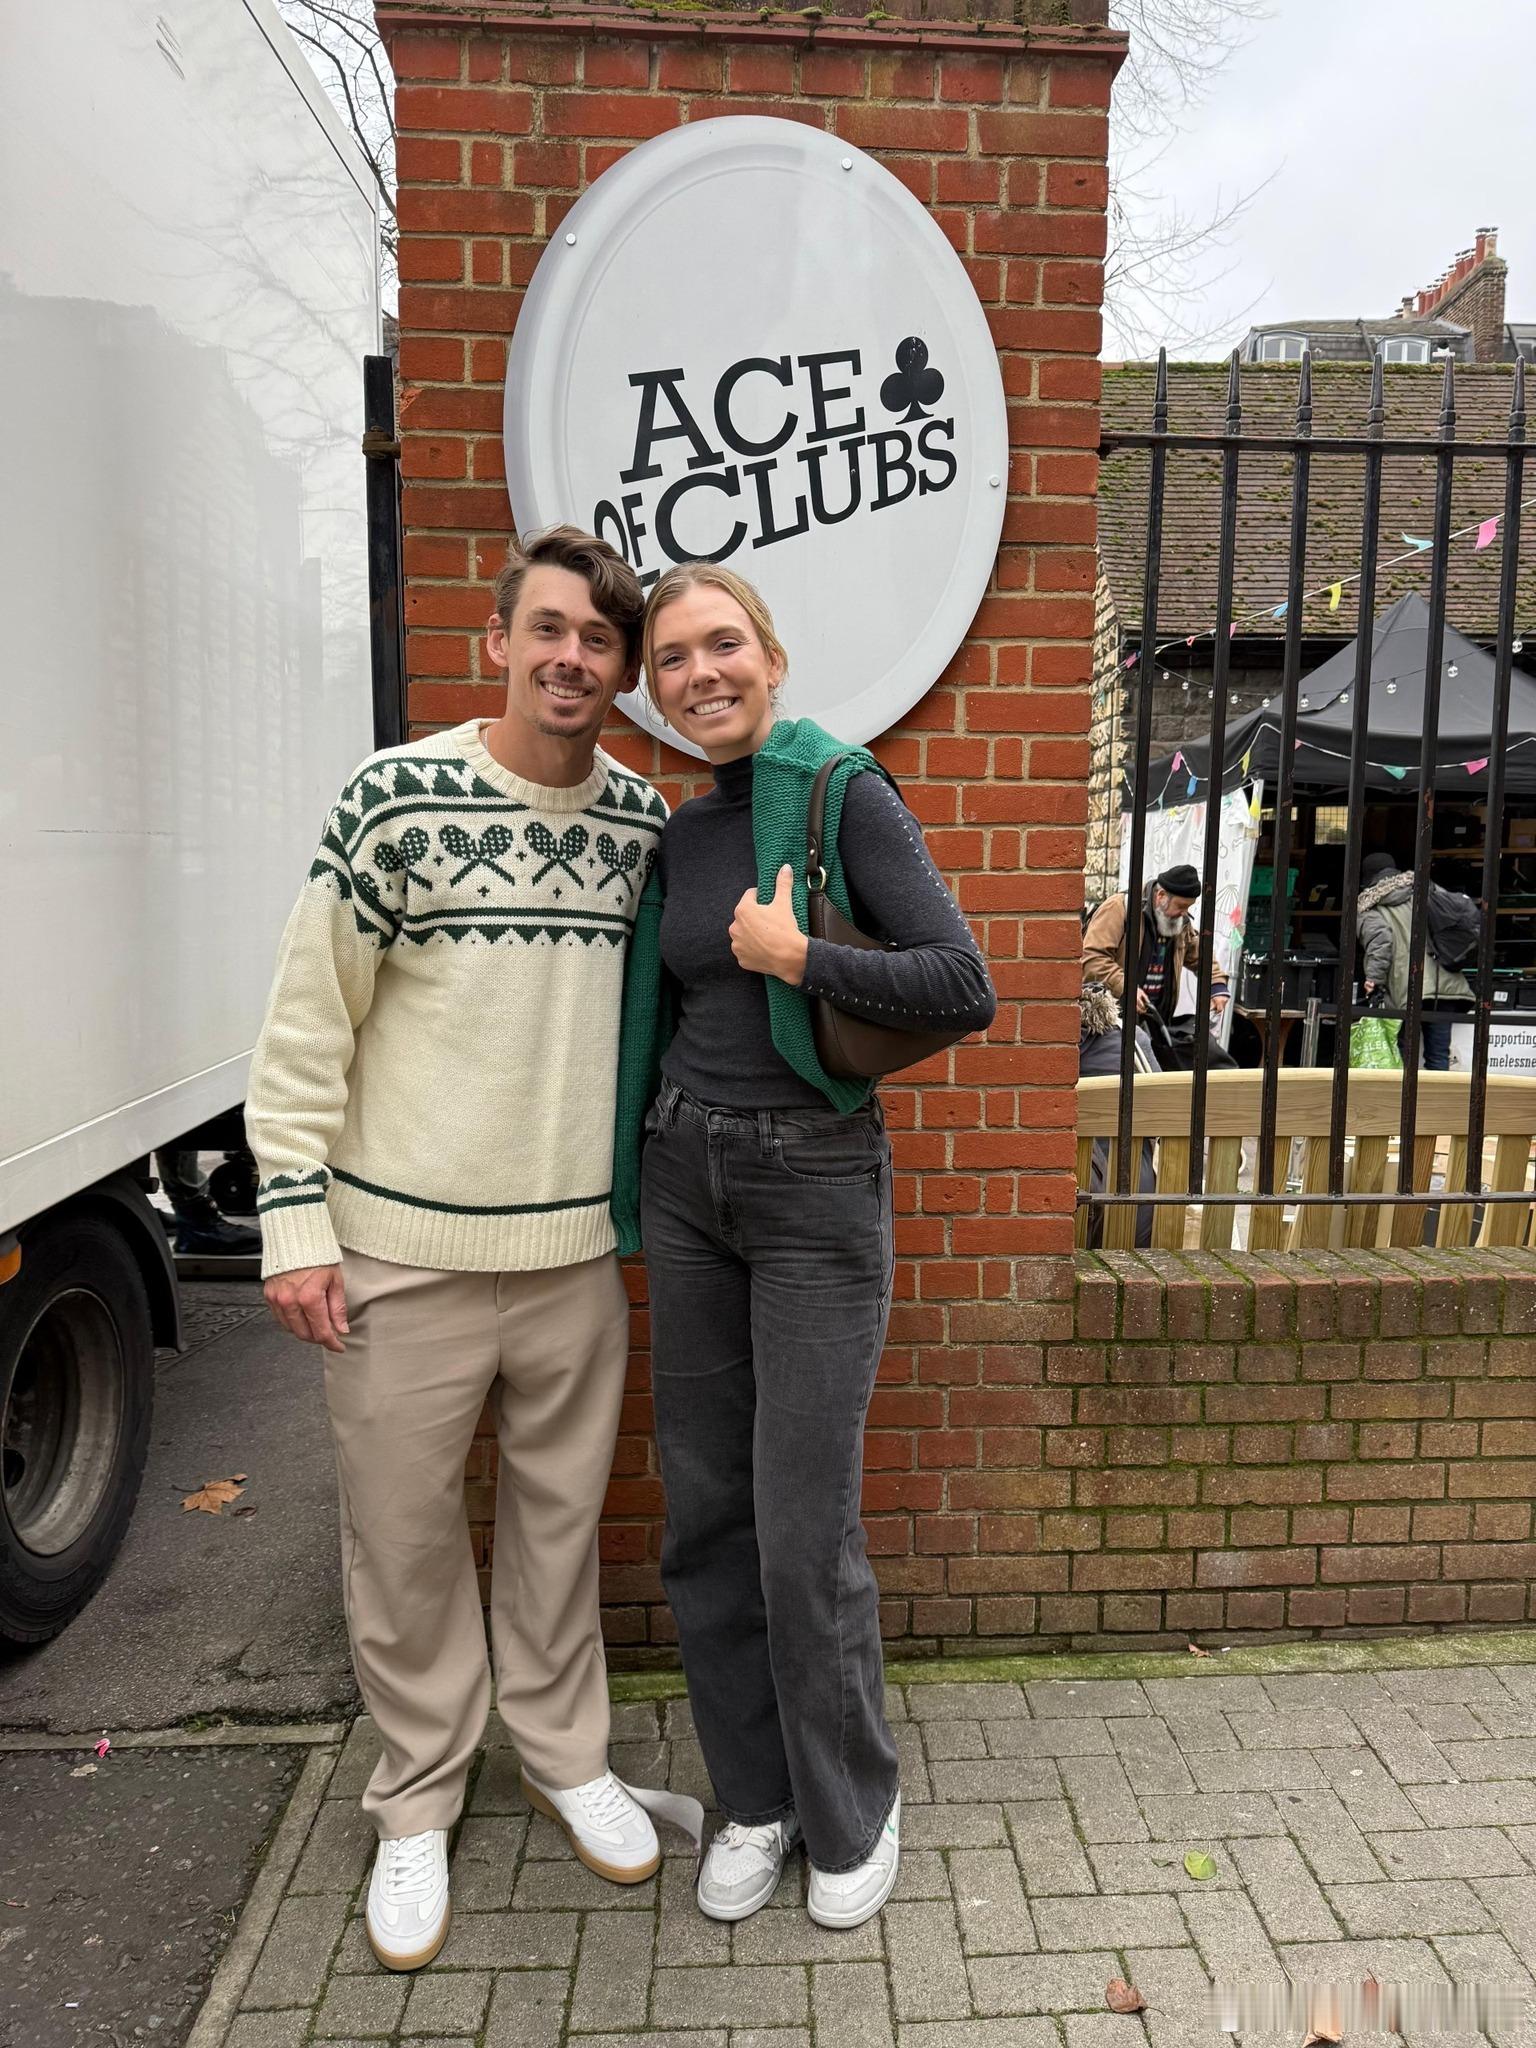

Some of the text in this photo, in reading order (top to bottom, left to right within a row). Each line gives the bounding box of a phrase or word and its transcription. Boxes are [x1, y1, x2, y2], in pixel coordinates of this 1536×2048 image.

[619, 349, 866, 484] ACE
[594, 417, 957, 569] OF CLUBS
[1488, 1031, 1536, 1048] upporting
